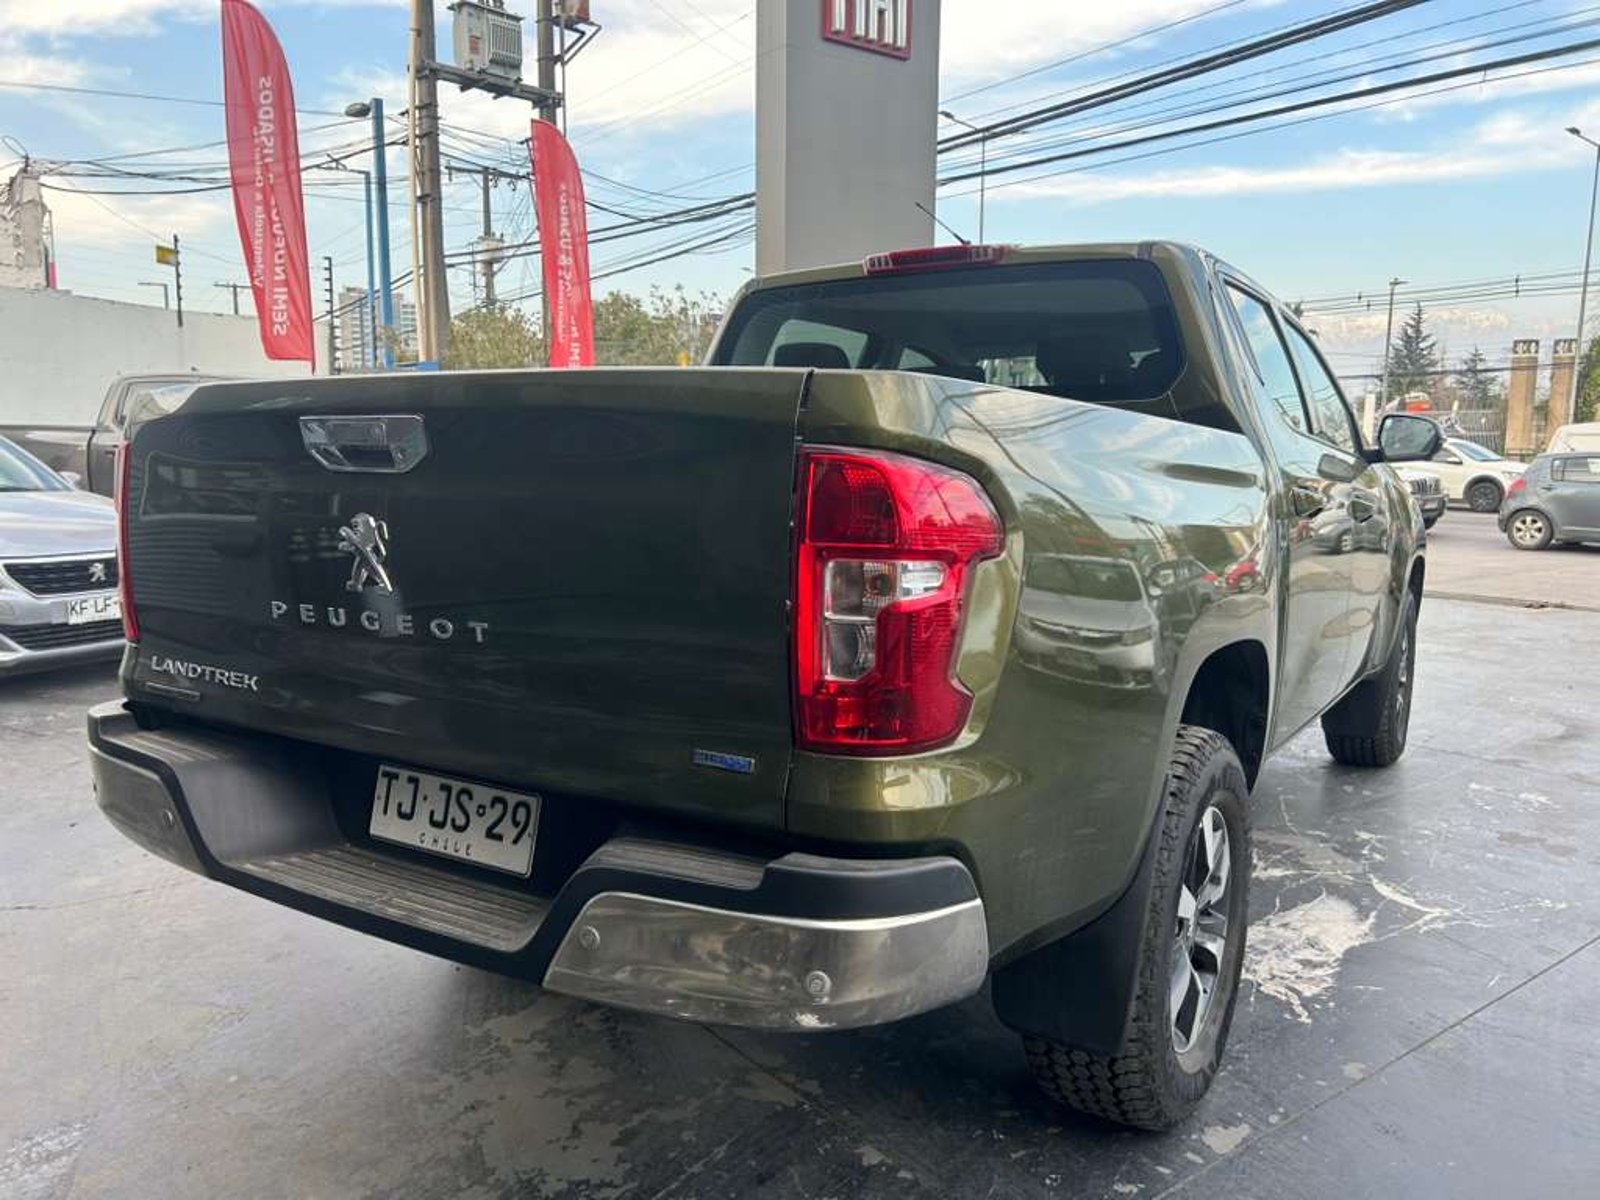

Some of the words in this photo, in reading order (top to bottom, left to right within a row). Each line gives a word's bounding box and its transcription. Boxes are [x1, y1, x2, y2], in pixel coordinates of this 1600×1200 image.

[270, 600, 489, 643] PEUGEOT
[151, 655, 259, 692] LANDTREK
[418, 832, 474, 857] CHILE
